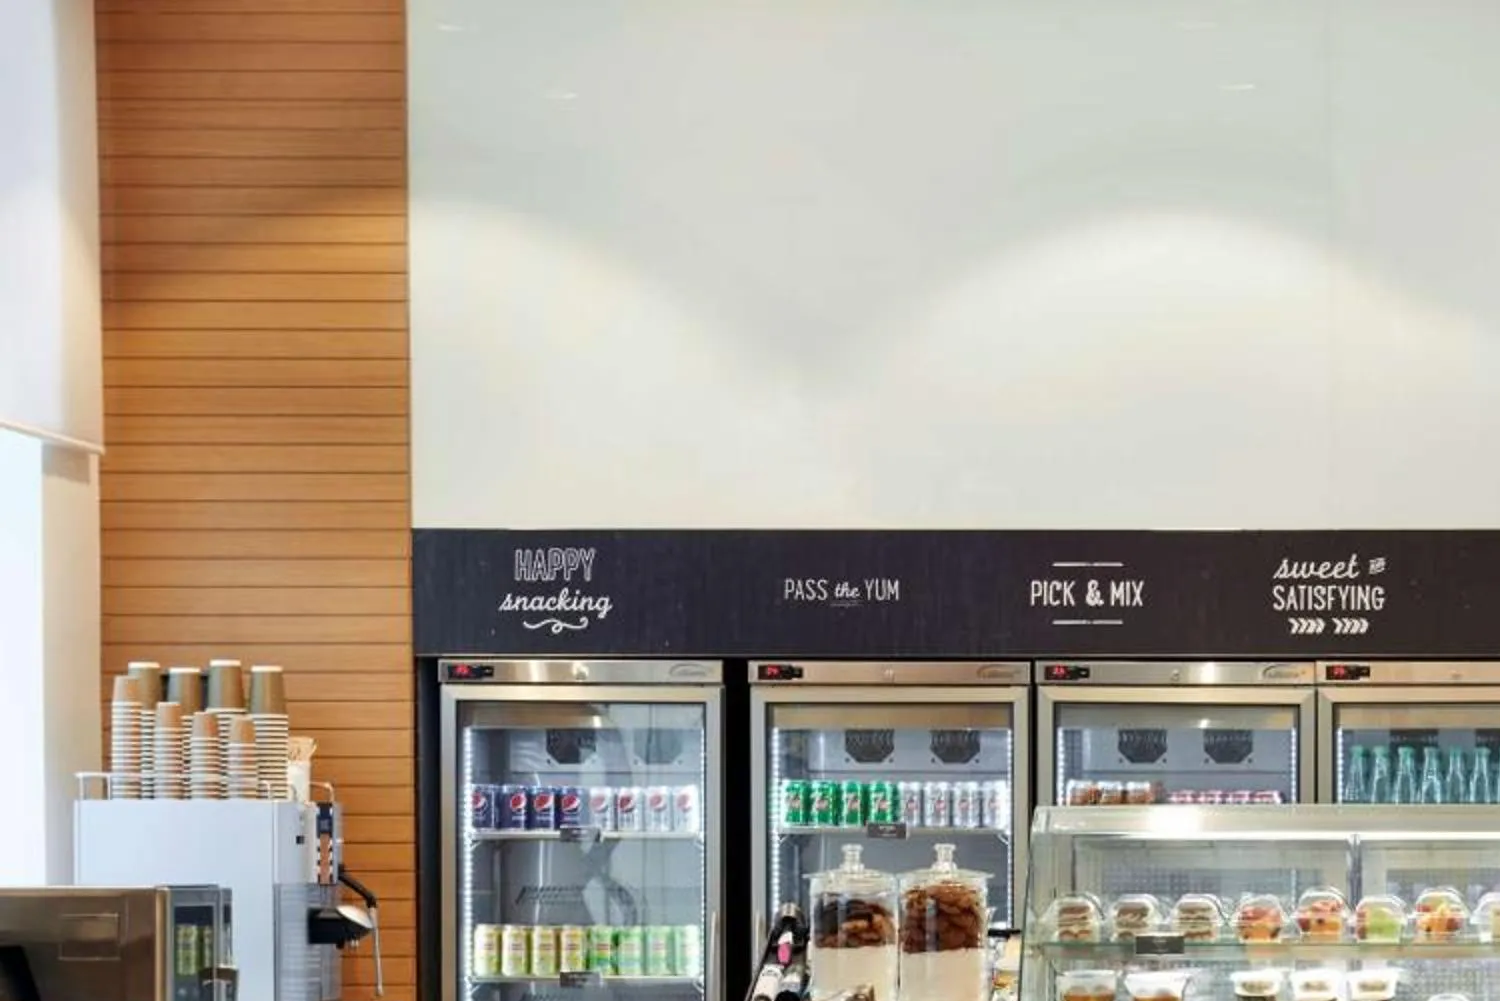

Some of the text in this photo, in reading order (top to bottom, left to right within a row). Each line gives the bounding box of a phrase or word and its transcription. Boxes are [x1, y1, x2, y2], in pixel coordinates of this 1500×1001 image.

[514, 547, 596, 582] HAPPY
[1273, 553, 1360, 579] sweet
[498, 587, 613, 618] snacking
[784, 578, 900, 601] PASS the YUM
[1030, 579, 1145, 607] PICK & MIX
[1272, 584, 1385, 611] SATISFYING
